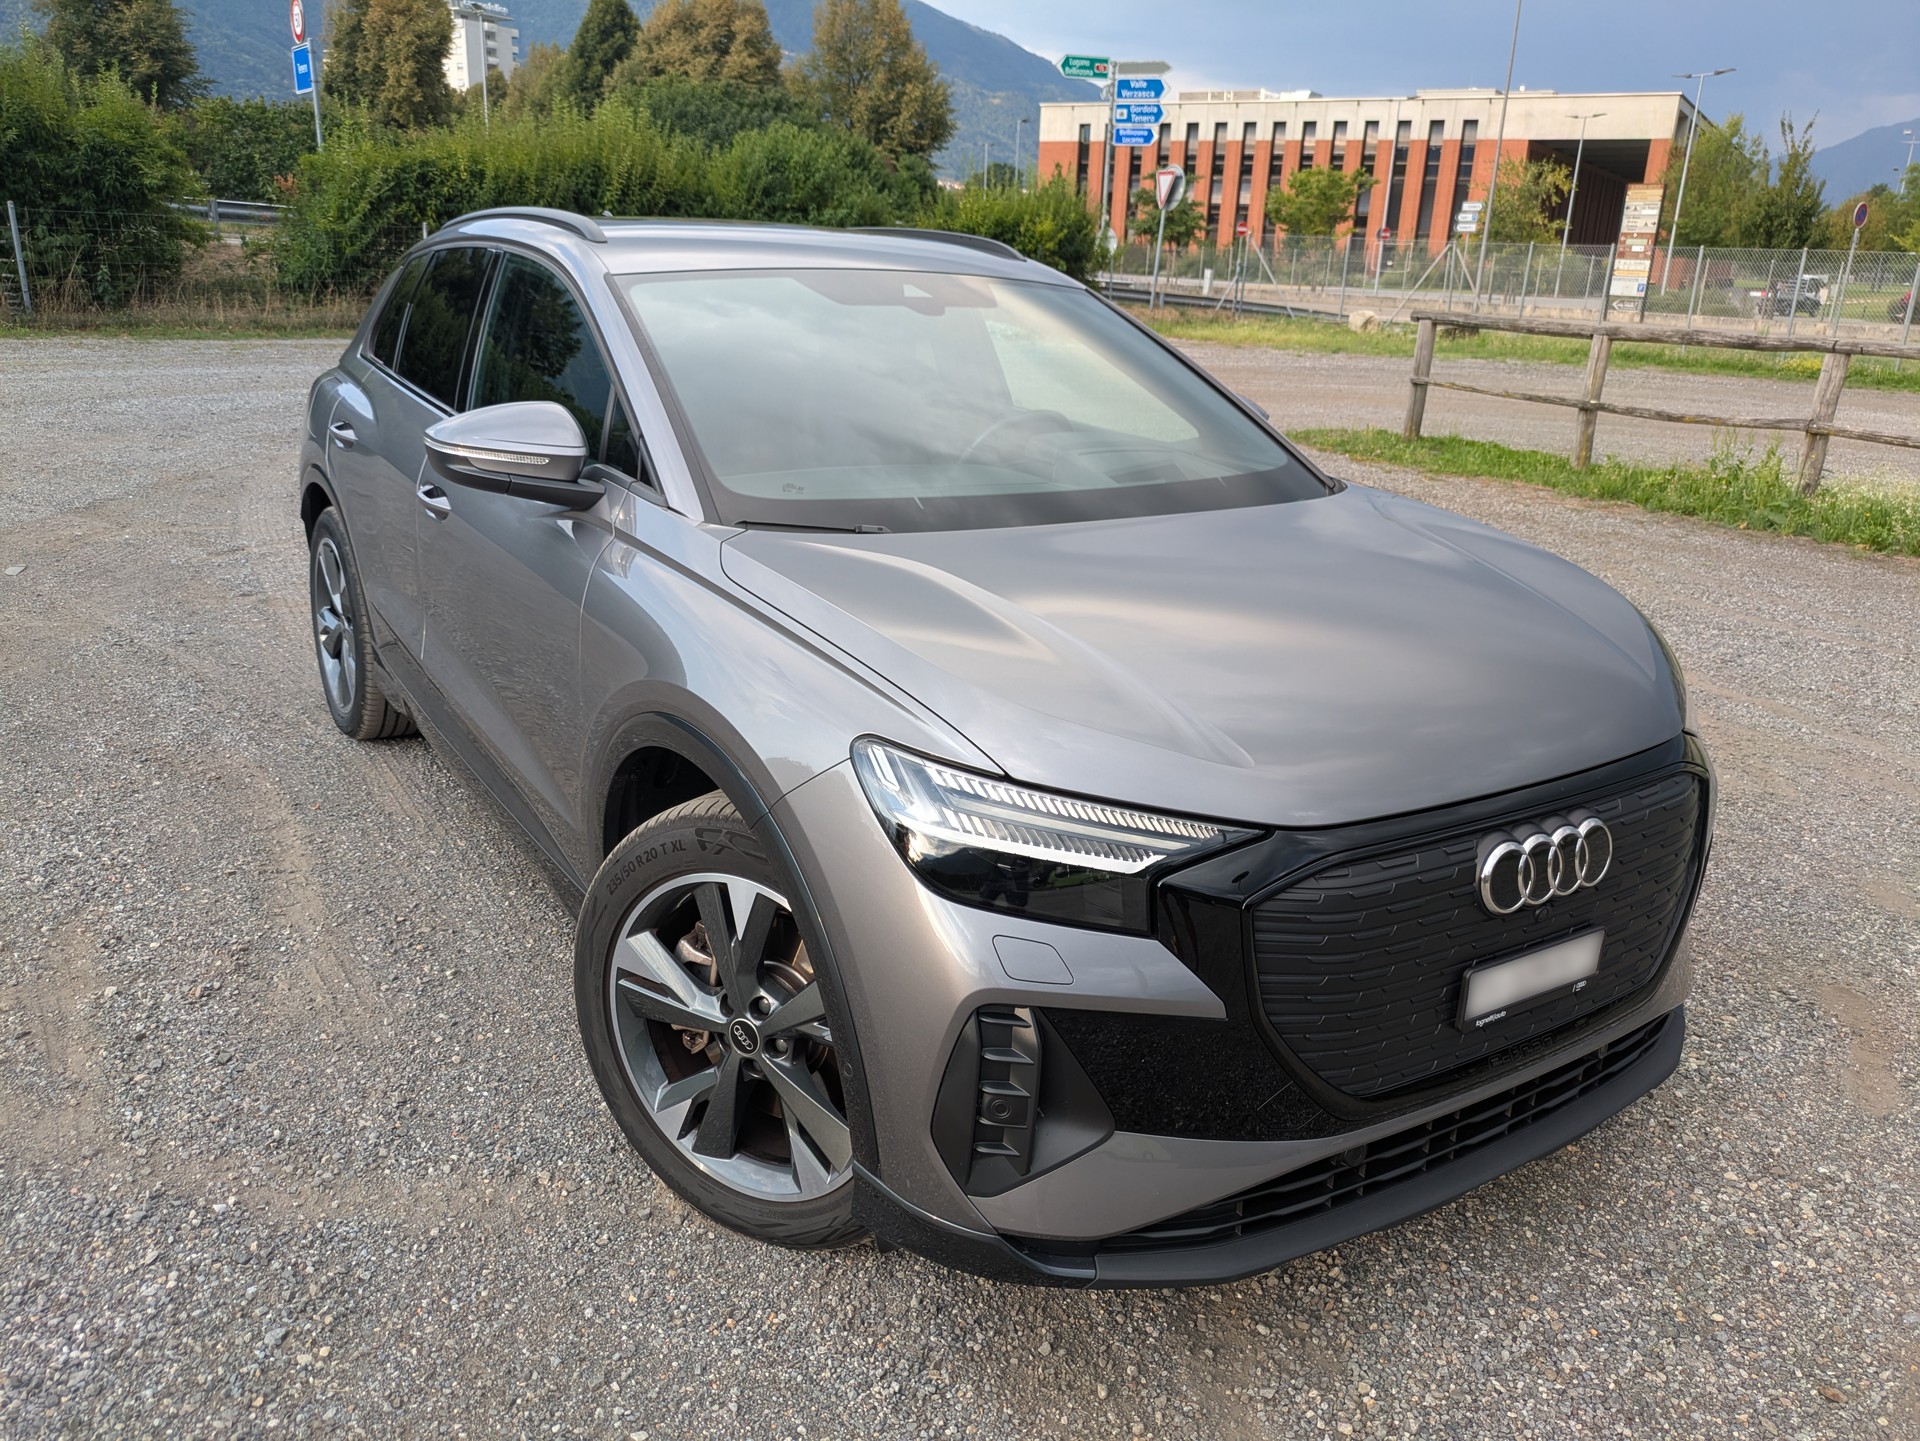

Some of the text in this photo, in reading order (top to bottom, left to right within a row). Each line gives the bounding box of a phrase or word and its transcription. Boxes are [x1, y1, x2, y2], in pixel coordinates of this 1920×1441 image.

[1069, 58, 1090, 68] Lugano
[1065, 67, 1094, 76] Bellinzona
[1130, 80, 1148, 88] Valle
[1121, 89, 1155, 98] Verzasca
[1130, 105, 1158, 114] Gordola
[1131, 114, 1155, 123] Tenero
[606, 860, 636, 895] 235/50
[670, 839, 686, 852] XL
